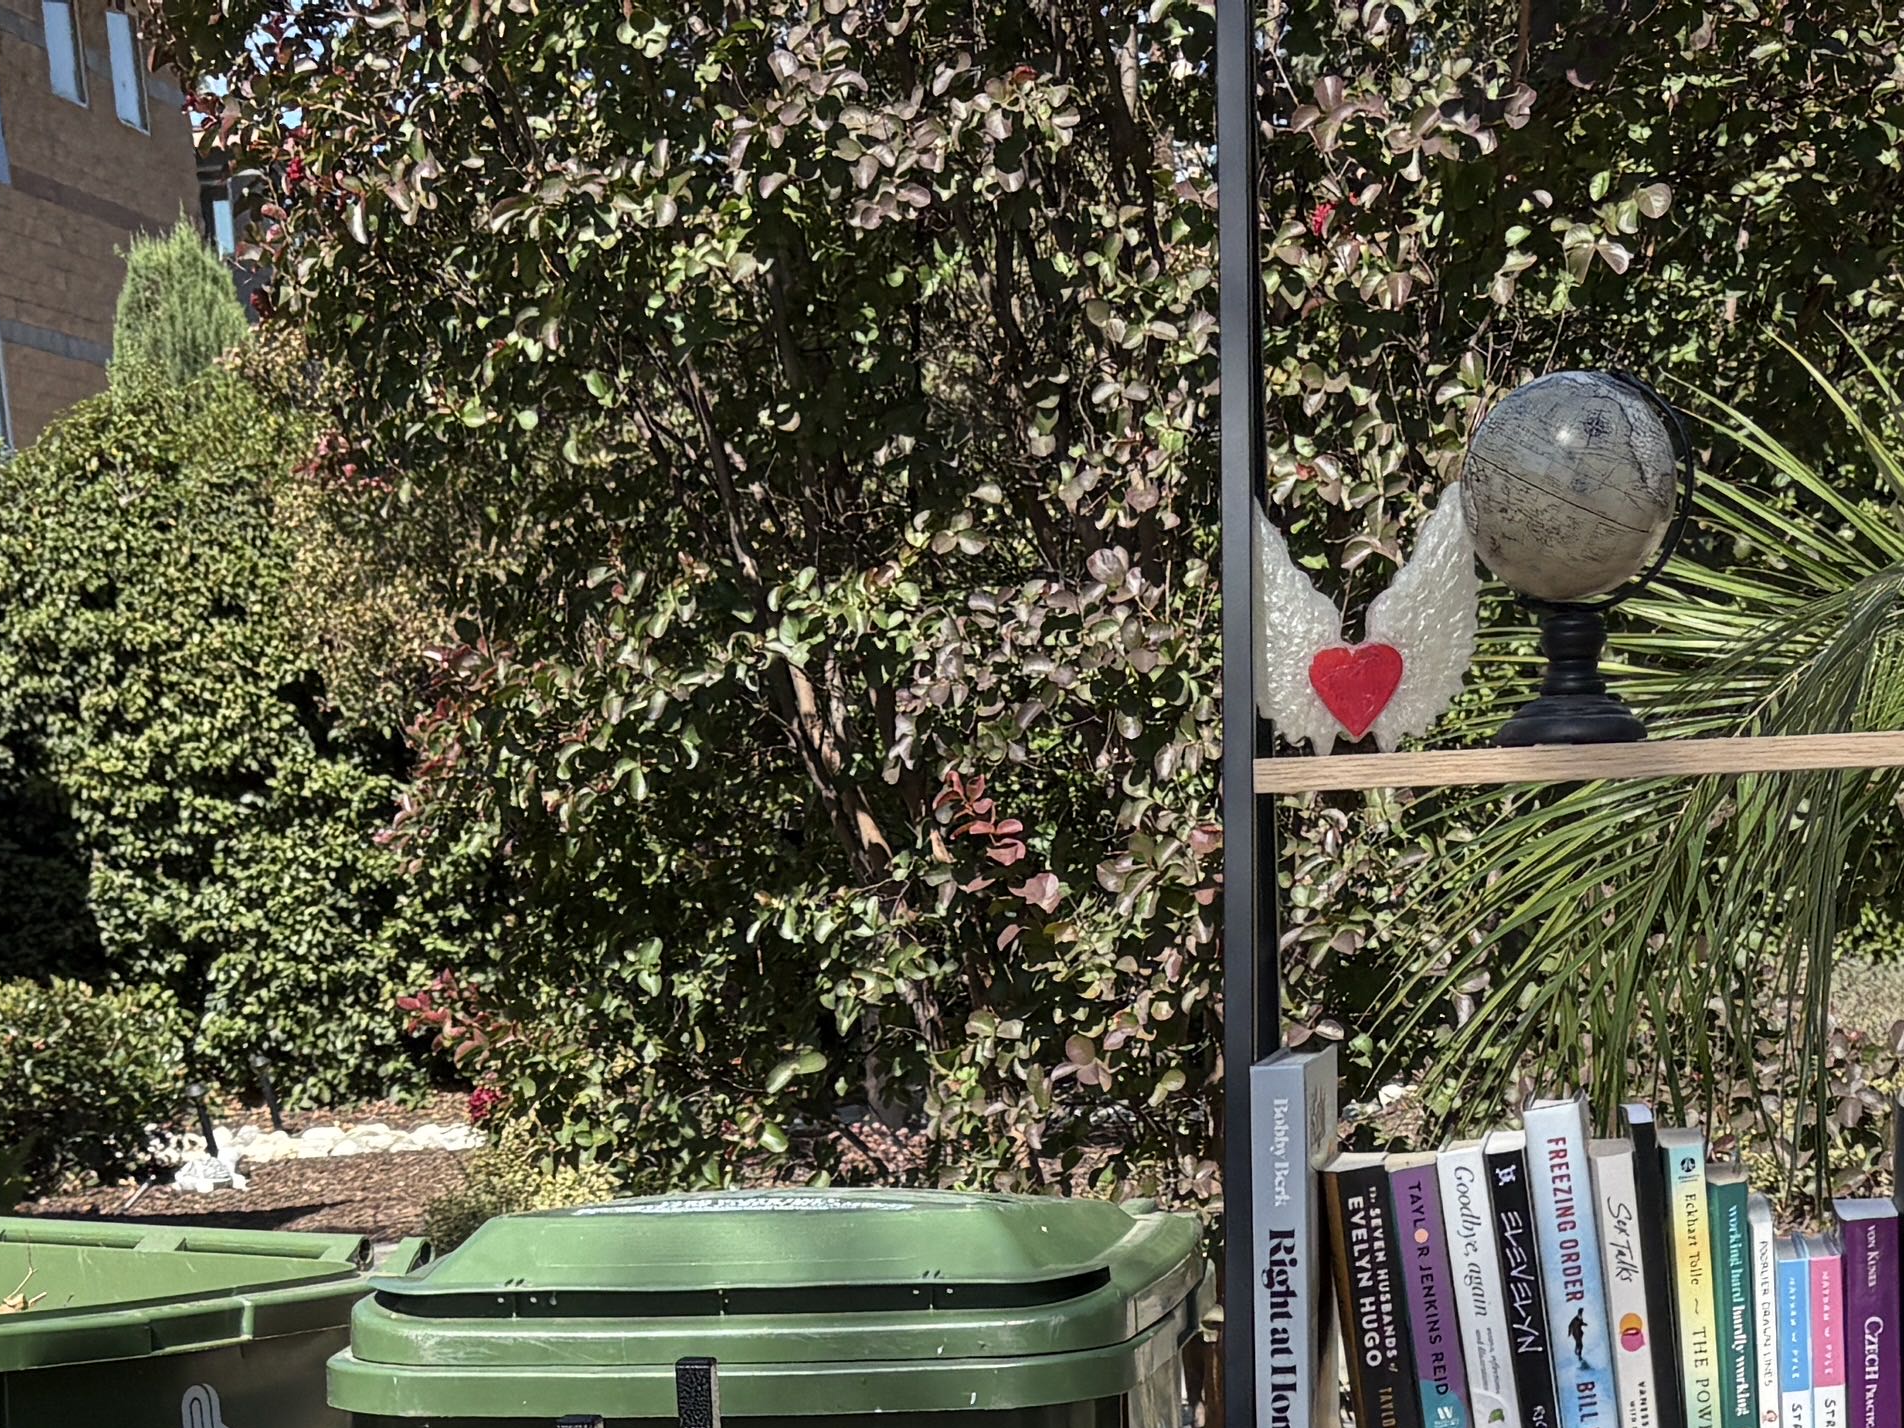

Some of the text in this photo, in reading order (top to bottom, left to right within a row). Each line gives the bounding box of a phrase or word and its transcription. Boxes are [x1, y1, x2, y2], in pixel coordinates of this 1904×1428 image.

[1272, 1099, 1291, 1207] Bobby Berk
[1454, 1166, 1487, 1317] Goodbye, again
[1547, 1136, 1585, 1303] FREEZING ORDER
[1610, 1240, 1639, 1283] Talks
[1684, 1193, 1704, 1285] Eckhart Tolle
[1261, 1229, 1298, 1323] Right
[1348, 1196, 1382, 1367] EVELYN HUGO
[1370, 1208, 1399, 1359] SEVEN HUSBANDS
[1270, 1325, 1293, 1358] at
[1419, 1265, 1442, 1345] JENKINS
[1431, 1352, 1449, 1397] REID
[1693, 1326, 1709, 1368] THE
[1864, 1316, 1884, 1380] CZECH
[1576, 1381, 1598, 1423] BILL
